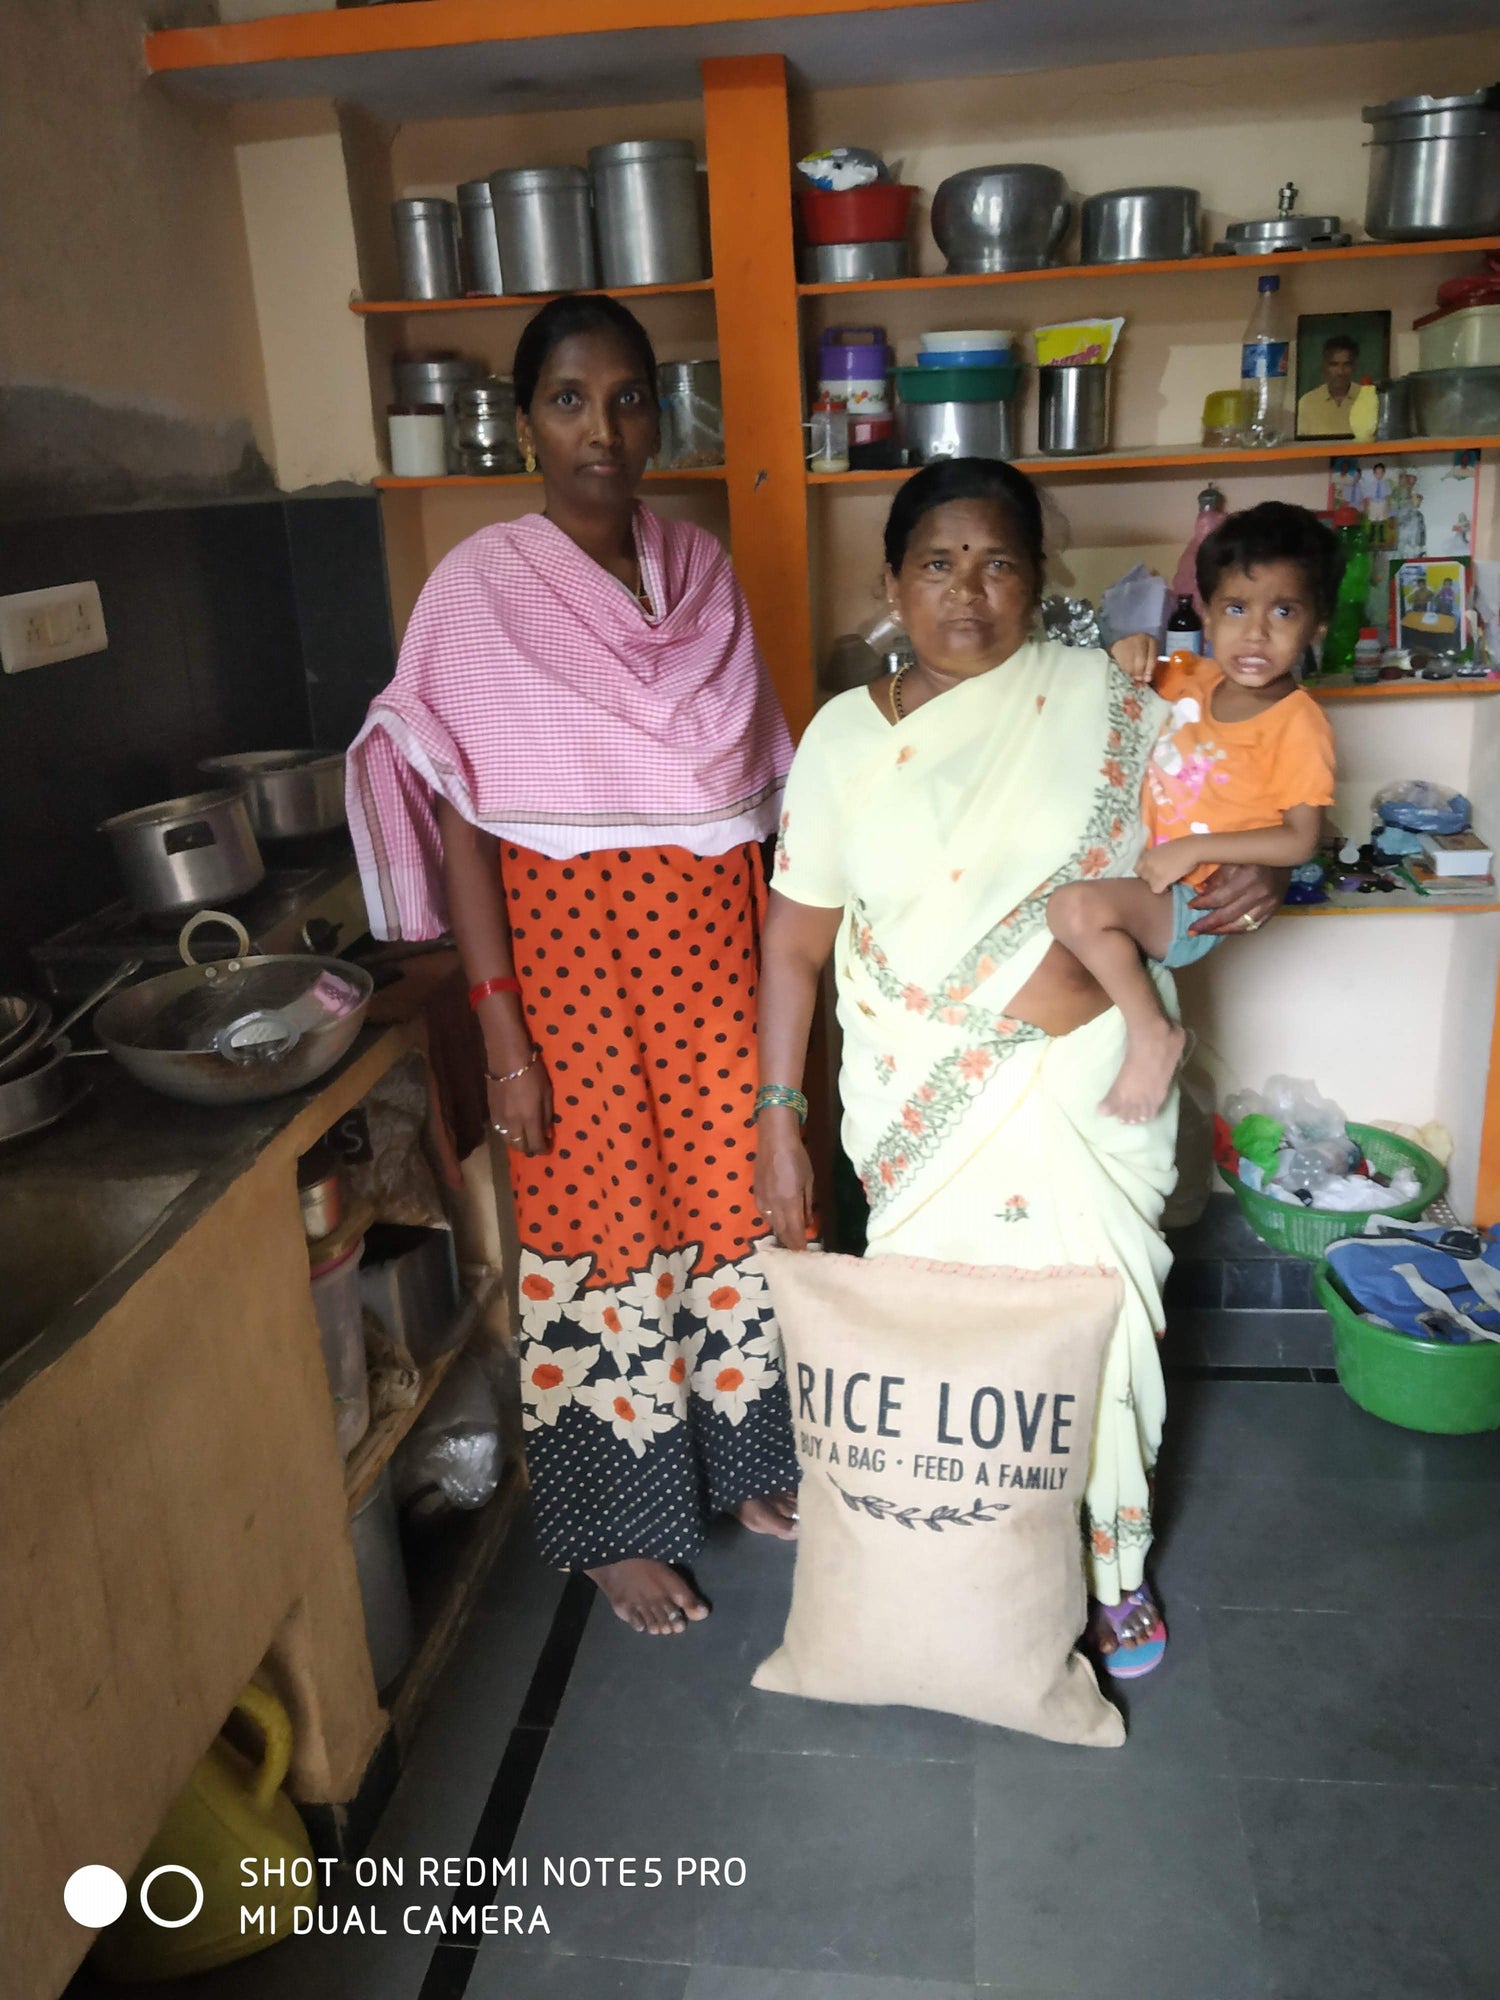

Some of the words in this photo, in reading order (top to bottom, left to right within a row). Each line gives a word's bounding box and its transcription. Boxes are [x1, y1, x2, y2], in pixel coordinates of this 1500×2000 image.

[797, 1362, 906, 1438] RICE
[937, 1382, 1075, 1454] LOVE
[800, 1431, 823, 1460] BUY
[829, 1441, 840, 1465] A
[848, 1444, 886, 1473] BAG
[913, 1454, 965, 1483] FEED
[974, 1461, 990, 1487] A
[999, 1463, 1069, 1491] FAMILY
